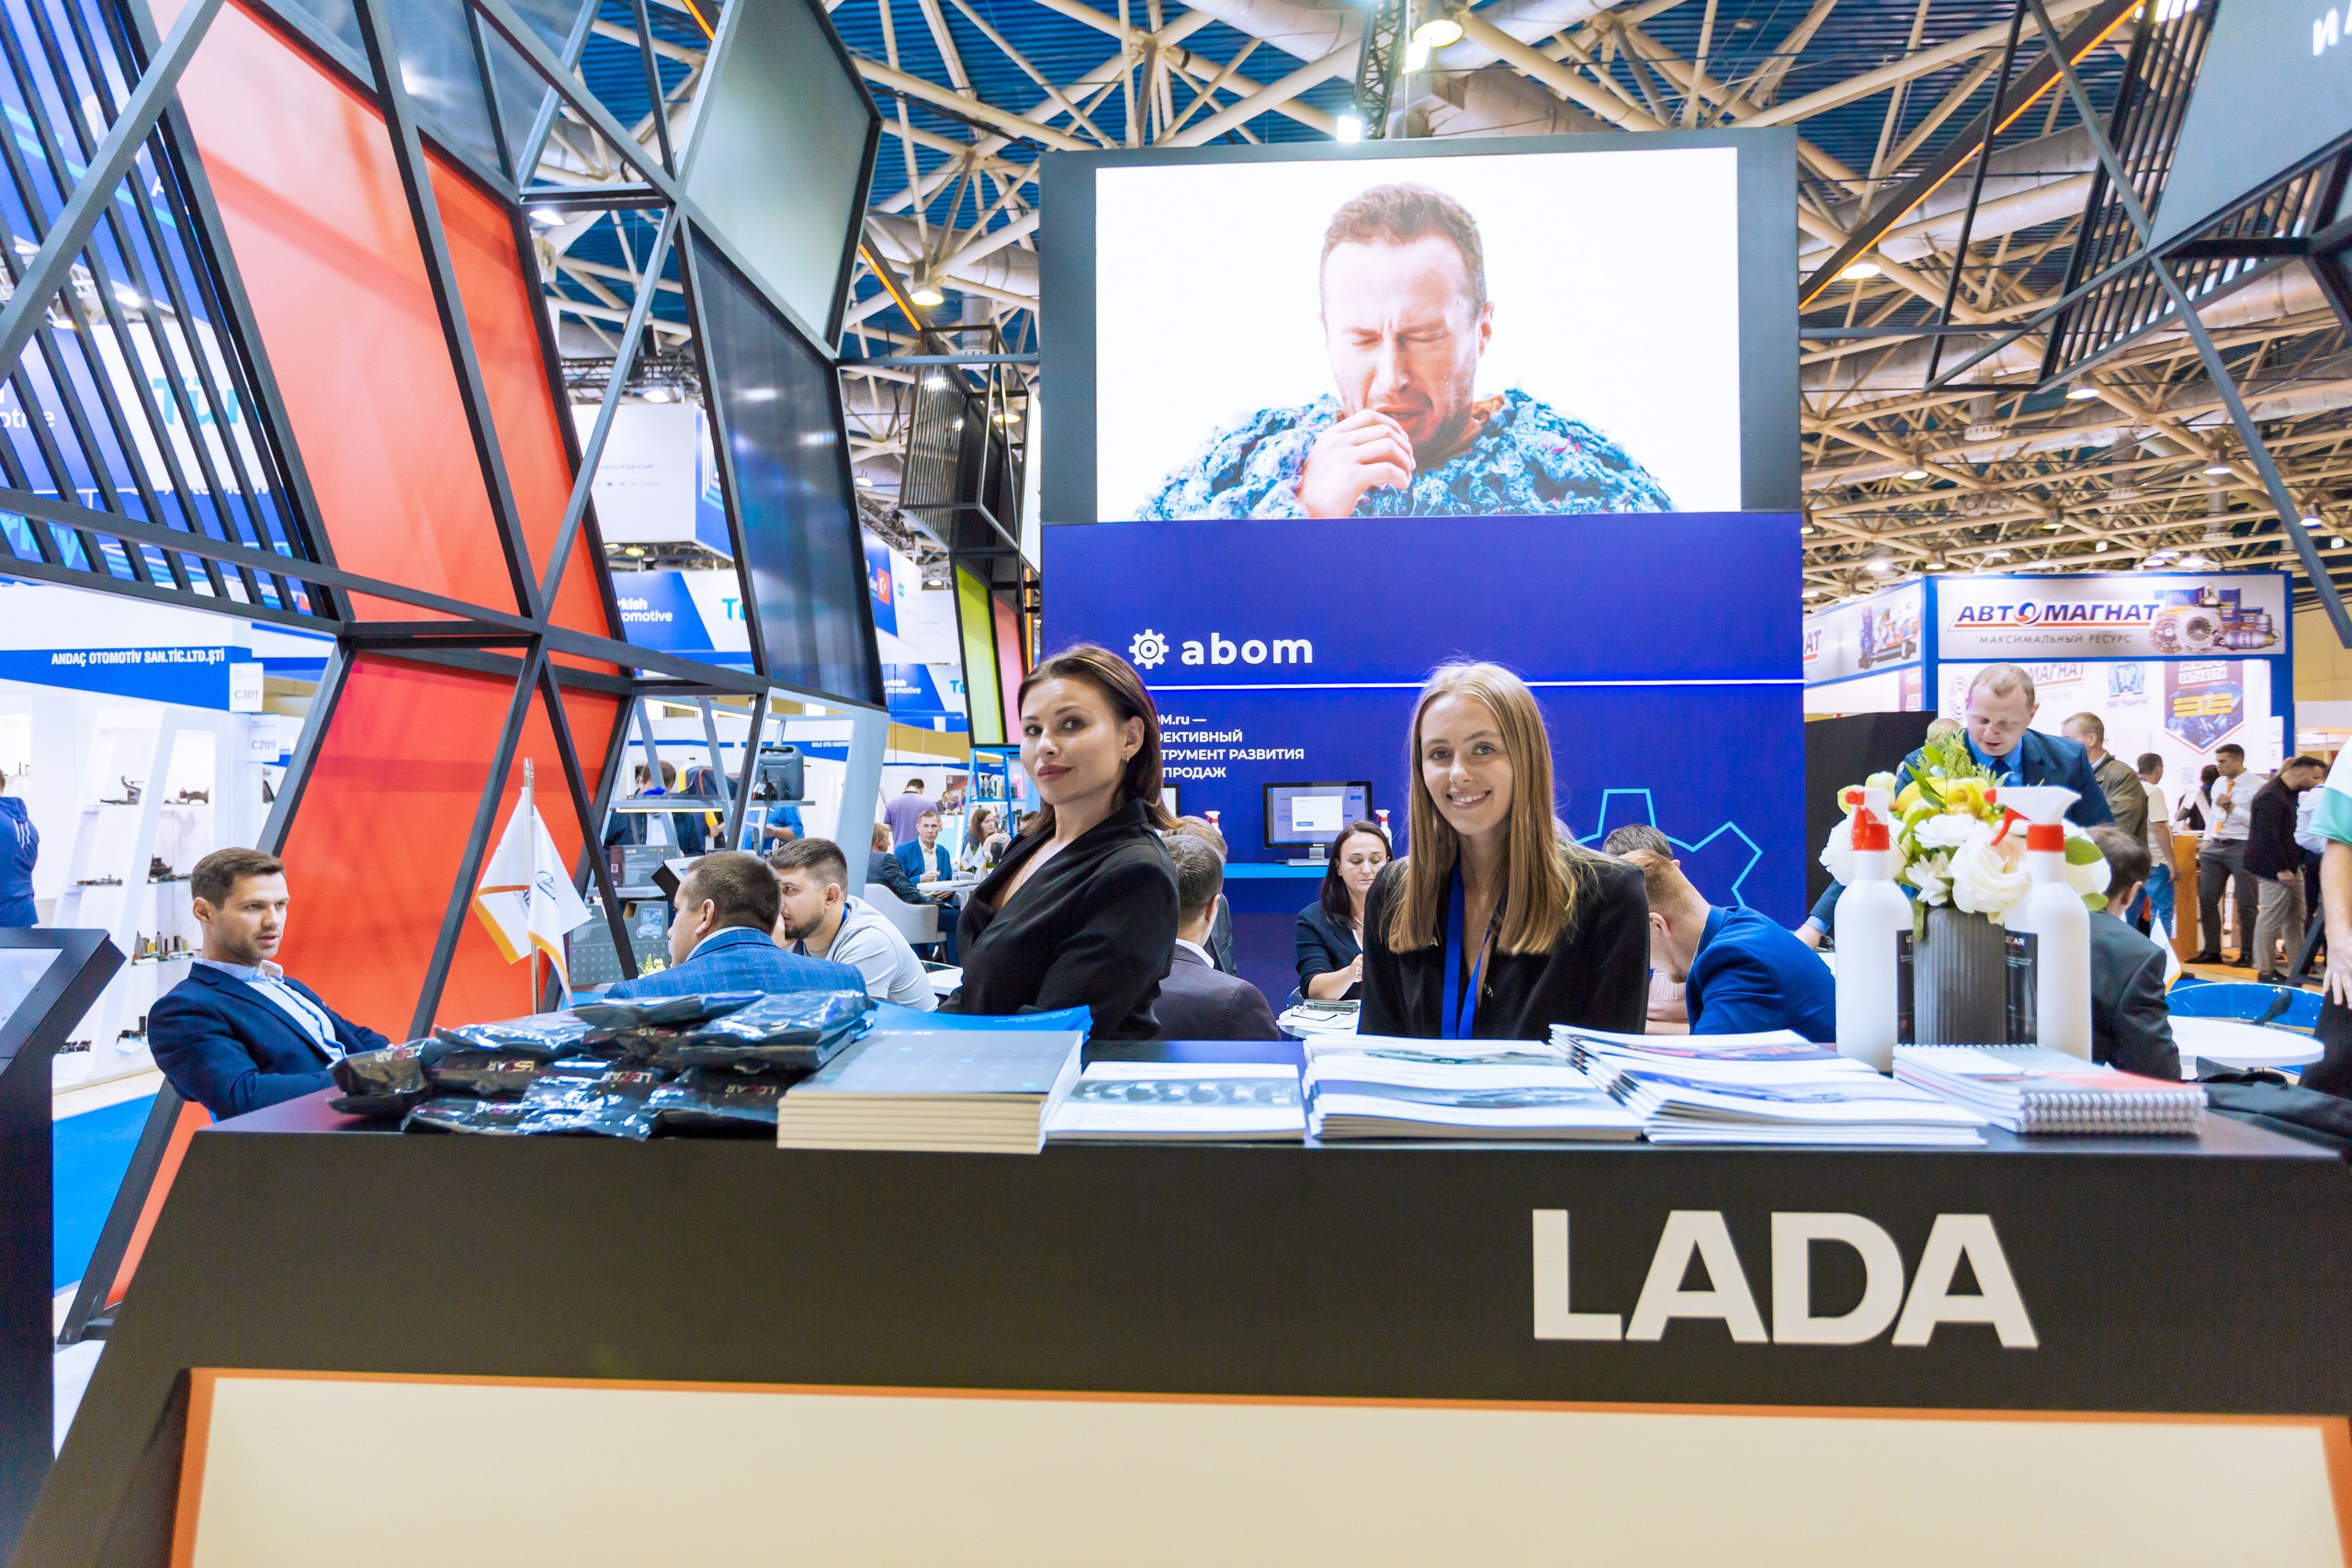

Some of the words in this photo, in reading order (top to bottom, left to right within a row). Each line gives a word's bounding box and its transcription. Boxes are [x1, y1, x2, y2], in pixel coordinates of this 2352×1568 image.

[1957, 602, 2160, 625] АВТОМАГНАТ
[1979, 633, 2082, 644] МАКСИМАЛЬНЫЙ
[2089, 634, 2132, 644] РЕСУРС
[1181, 632, 1314, 666] abom
[51, 652, 86, 667] ANDAÇ
[89, 649, 142, 665] OTOMOTİV
[234, 690, 259, 700] C301
[252, 740, 277, 750] C209
[1229, 749, 1305, 760] РАЗВИТИЯ
[1162, 767, 1227, 779] ПРОДАЖ
[1532, 1209, 2040, 1348] LADA
